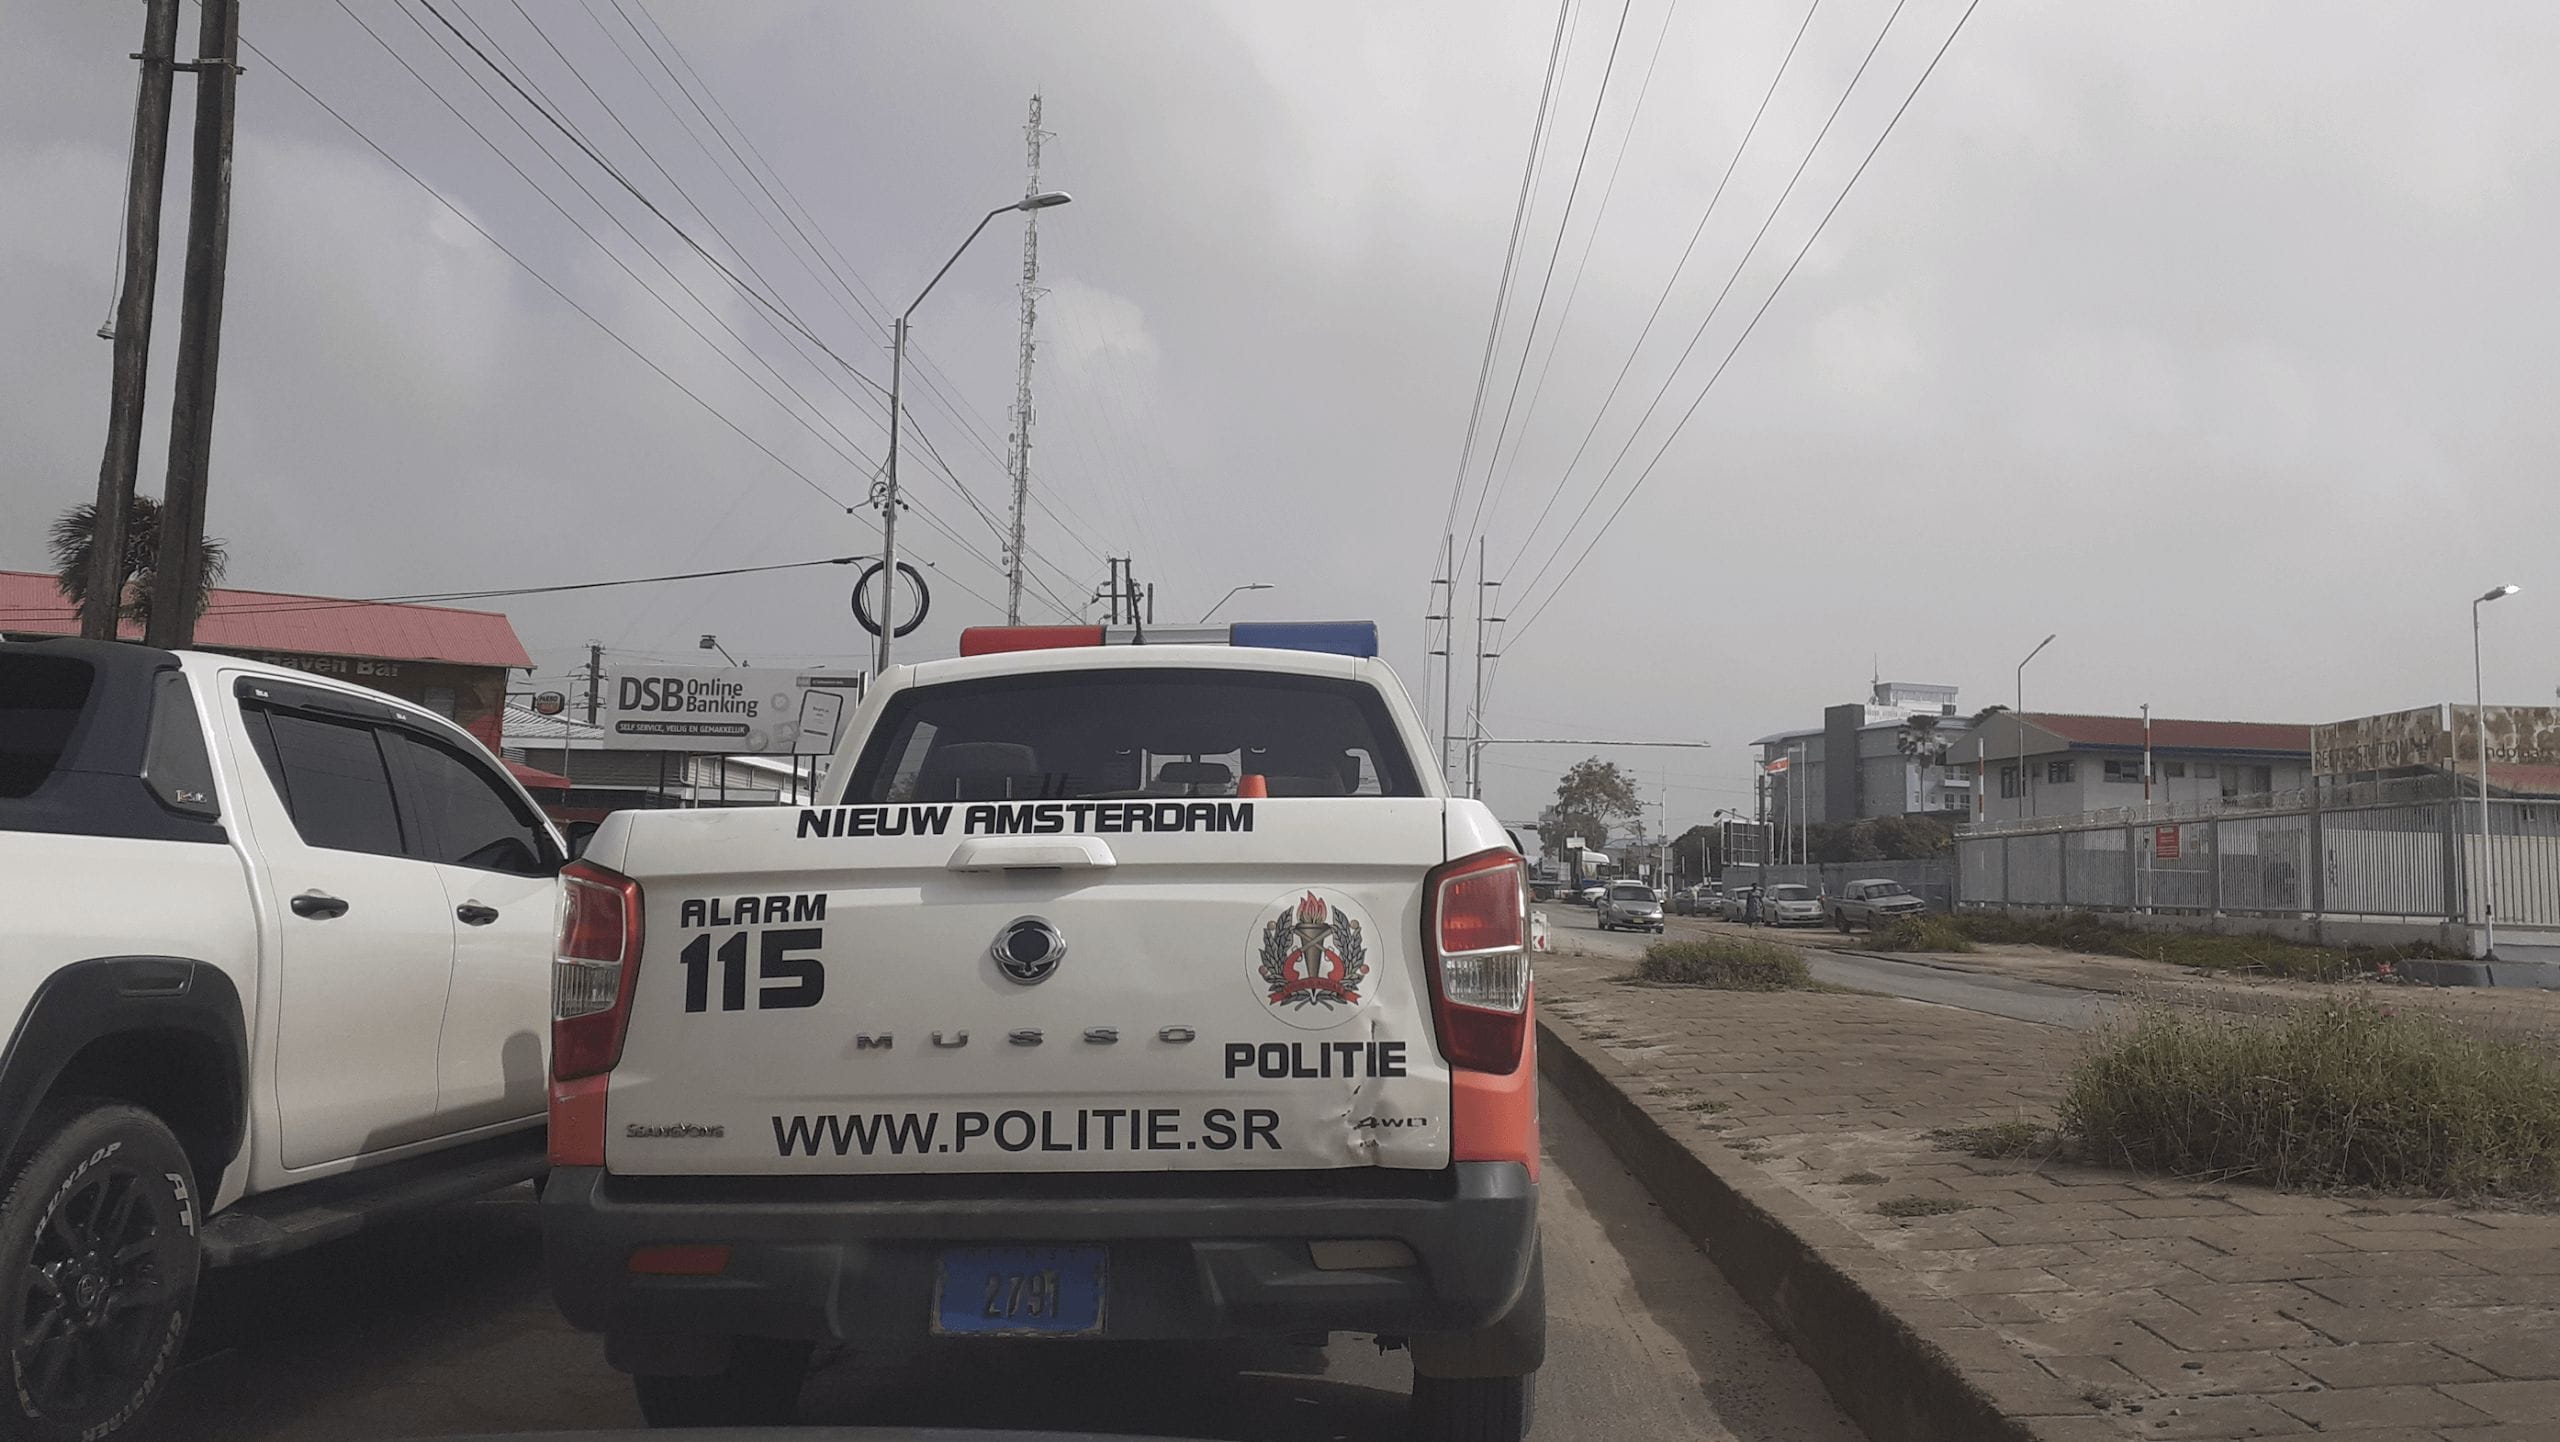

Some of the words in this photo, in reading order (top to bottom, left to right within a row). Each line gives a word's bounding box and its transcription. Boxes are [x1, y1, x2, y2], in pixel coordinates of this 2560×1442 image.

[357, 660, 401, 677] Bar
[619, 676, 684, 712] DSB
[687, 678, 743, 696] Online
[686, 695, 758, 717] Banking
[619, 723, 636, 731] SELF
[688, 724, 698, 732] EN
[796, 804, 953, 839] NIEUW
[964, 803, 1254, 835] AMSTERDAM
[680, 893, 827, 928] ALARM
[680, 928, 825, 1013] 115
[856, 1025, 1196, 1050] MUSSO
[1225, 1041, 1407, 1079] POLITIE
[772, 1108, 1283, 1158] WWW.POLITIE.SR
[35, 1141, 122, 1240] DUNLOP
[983, 1269, 1061, 1319] 2791
